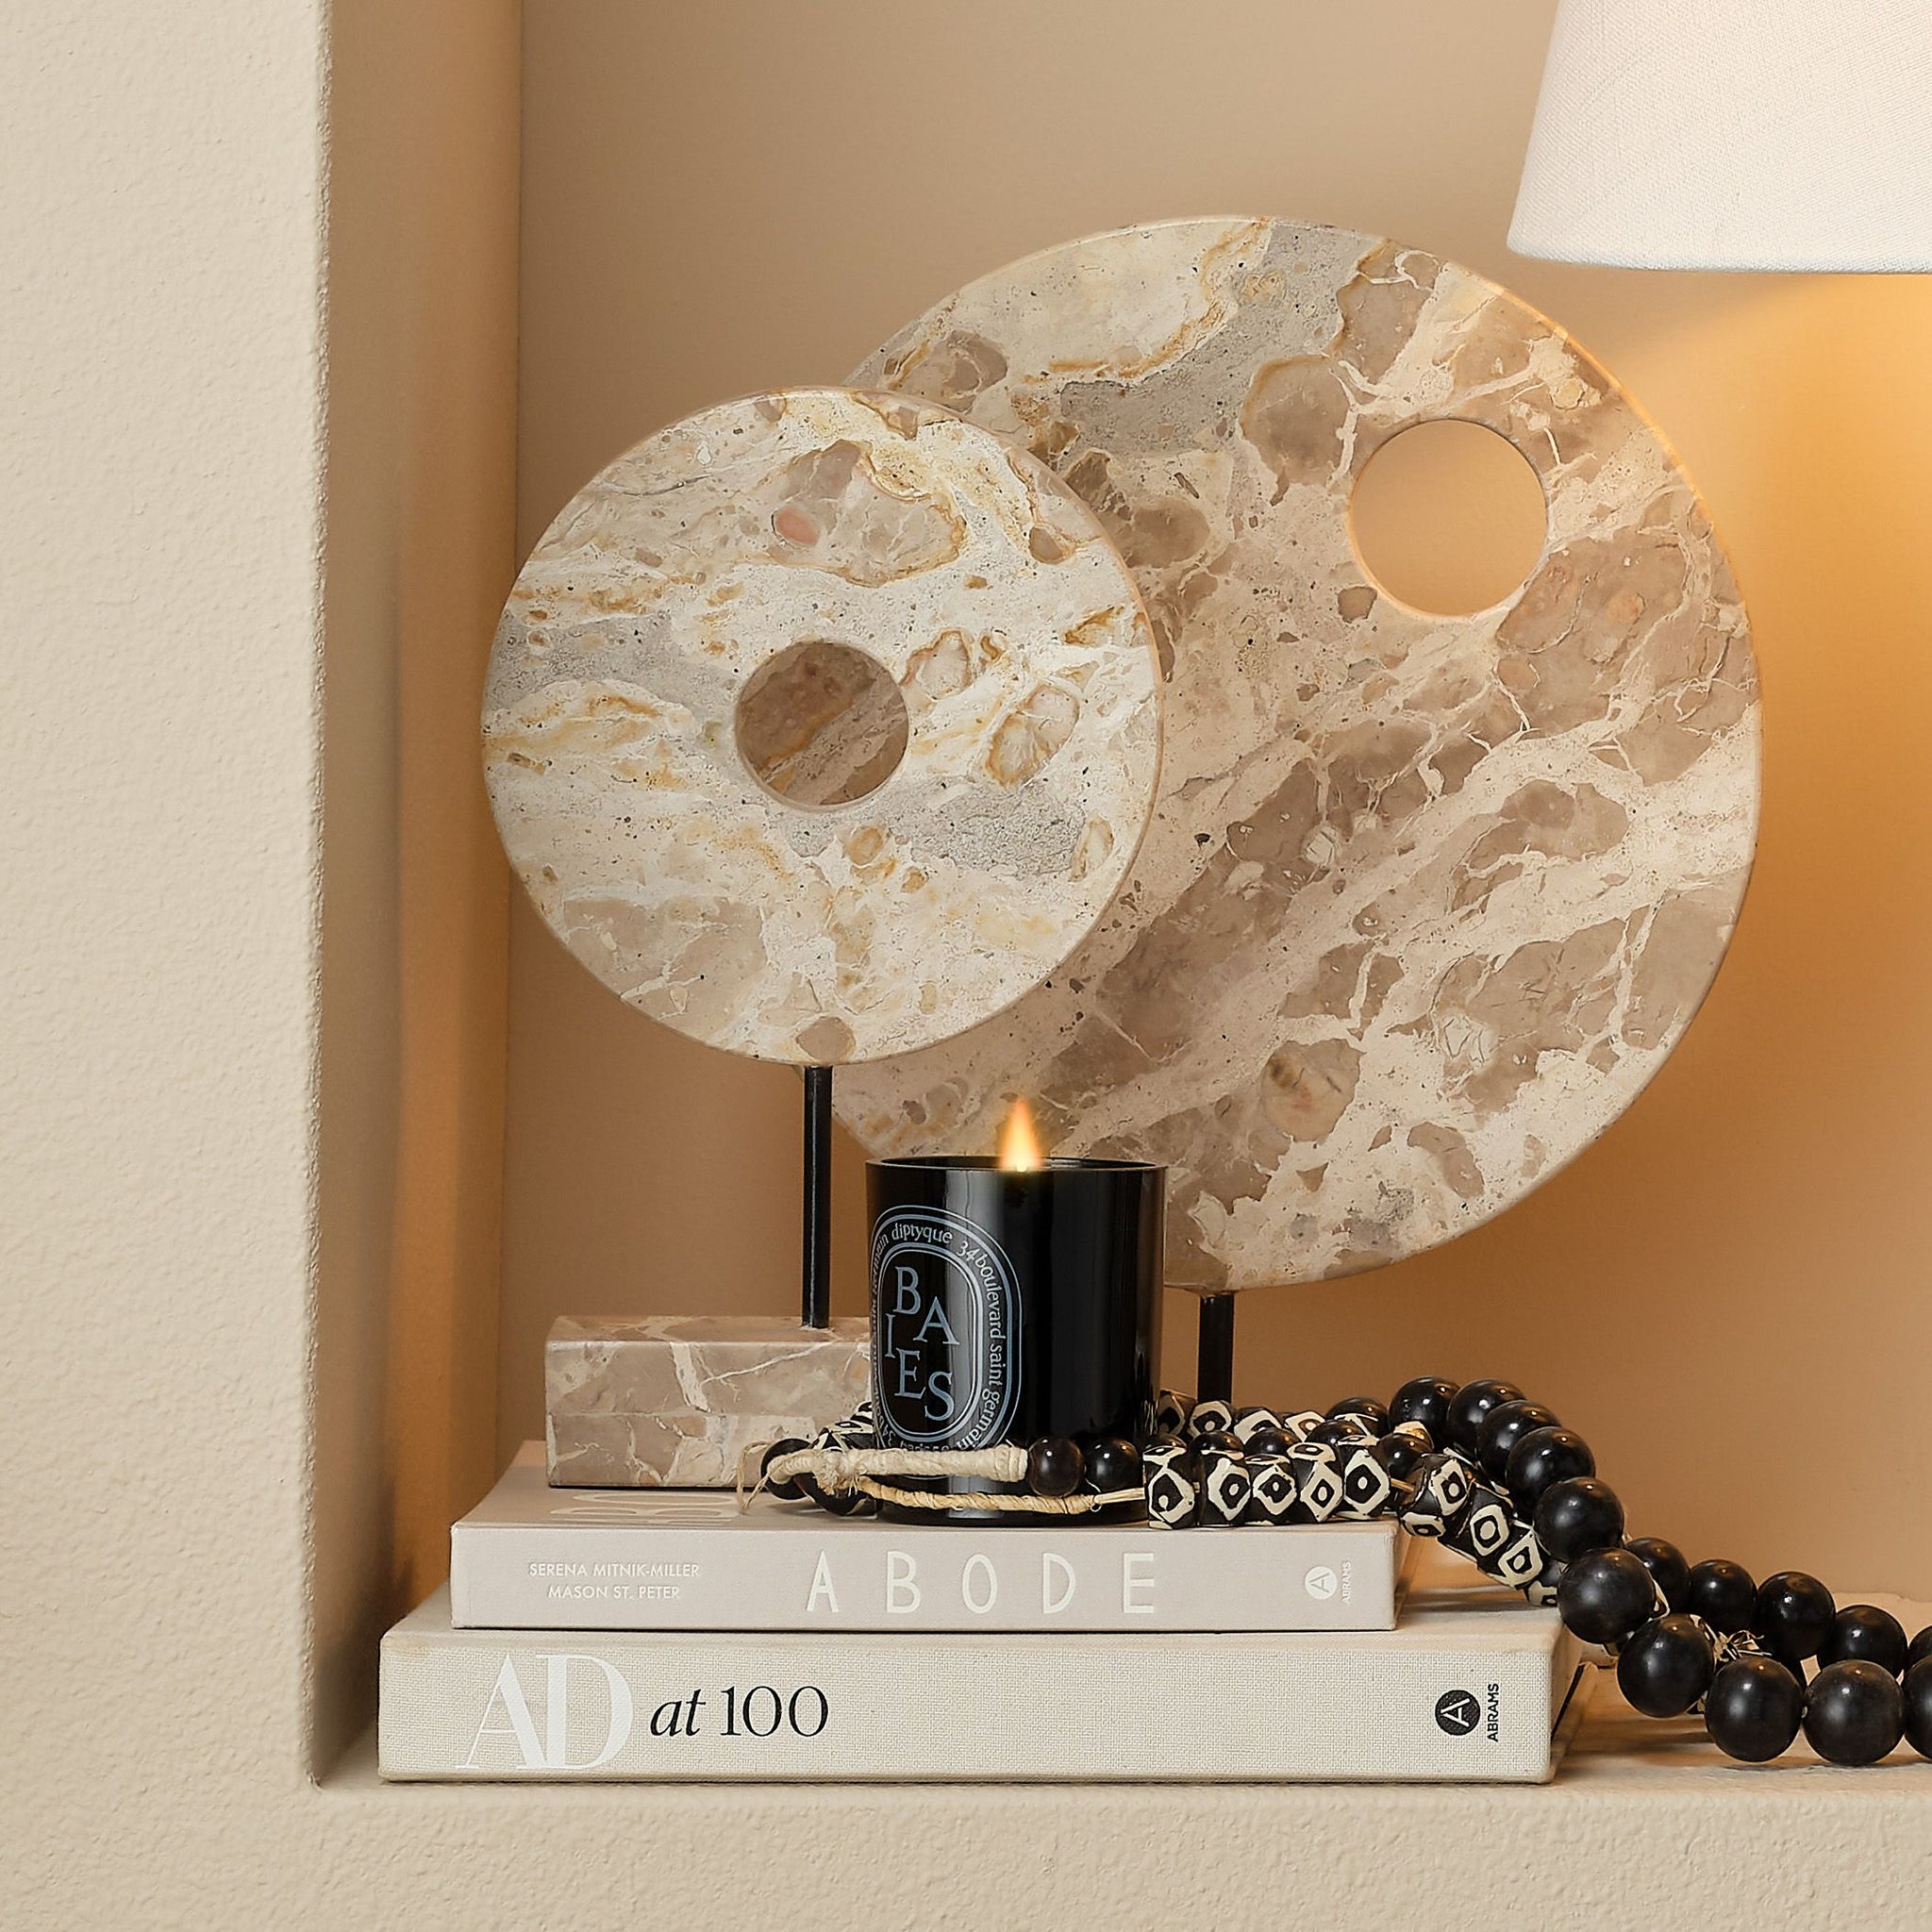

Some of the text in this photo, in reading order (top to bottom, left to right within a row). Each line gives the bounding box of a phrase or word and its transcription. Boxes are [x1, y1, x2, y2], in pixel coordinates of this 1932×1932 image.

[891, 1222, 953, 1244] diptyque
[988, 1344, 1008, 1386] saint
[956, 1388, 1001, 1451] germain
[528, 1562, 701, 1578] SERENA MITNIK-MILLER
[806, 1550, 1156, 1614] ABODE
[1341, 1560, 1352, 1605] ABRAMS
[547, 1585, 681, 1601] MASON ST. PETER
[455, 1653, 830, 1770] AD at 100
[1487, 1682, 1500, 1743] ABRAMS
